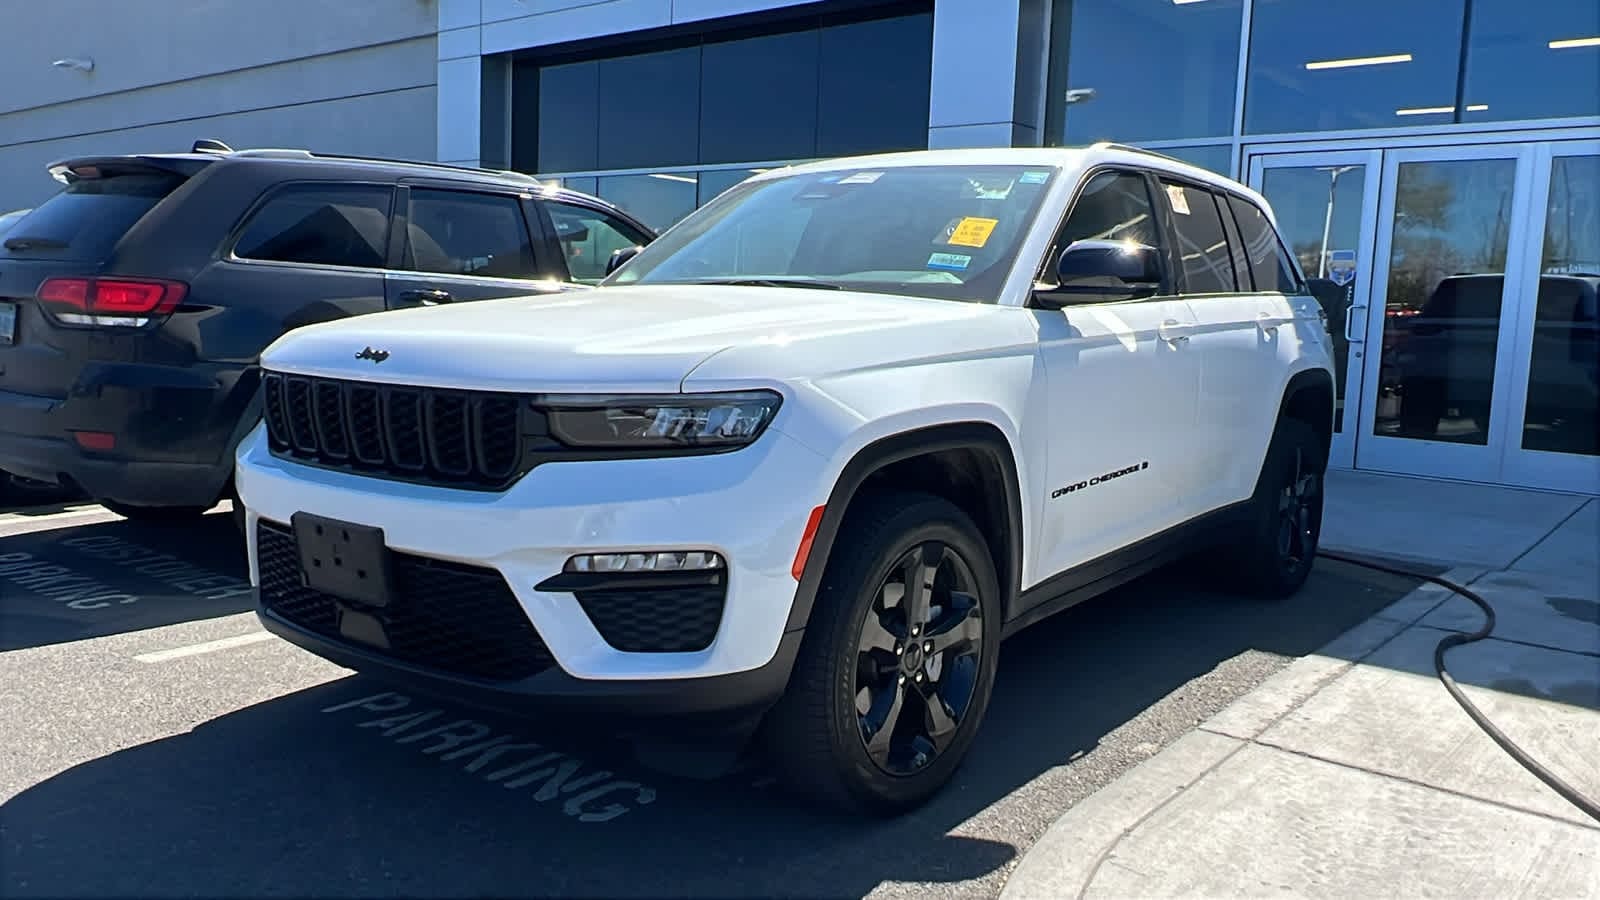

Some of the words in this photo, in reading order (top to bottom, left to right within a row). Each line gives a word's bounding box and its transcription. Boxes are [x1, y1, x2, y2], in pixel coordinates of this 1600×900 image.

[1051, 481, 1087, 498] GRAND
[1089, 464, 1140, 485] CHEROKEE
[320, 691, 656, 823] PARKING
